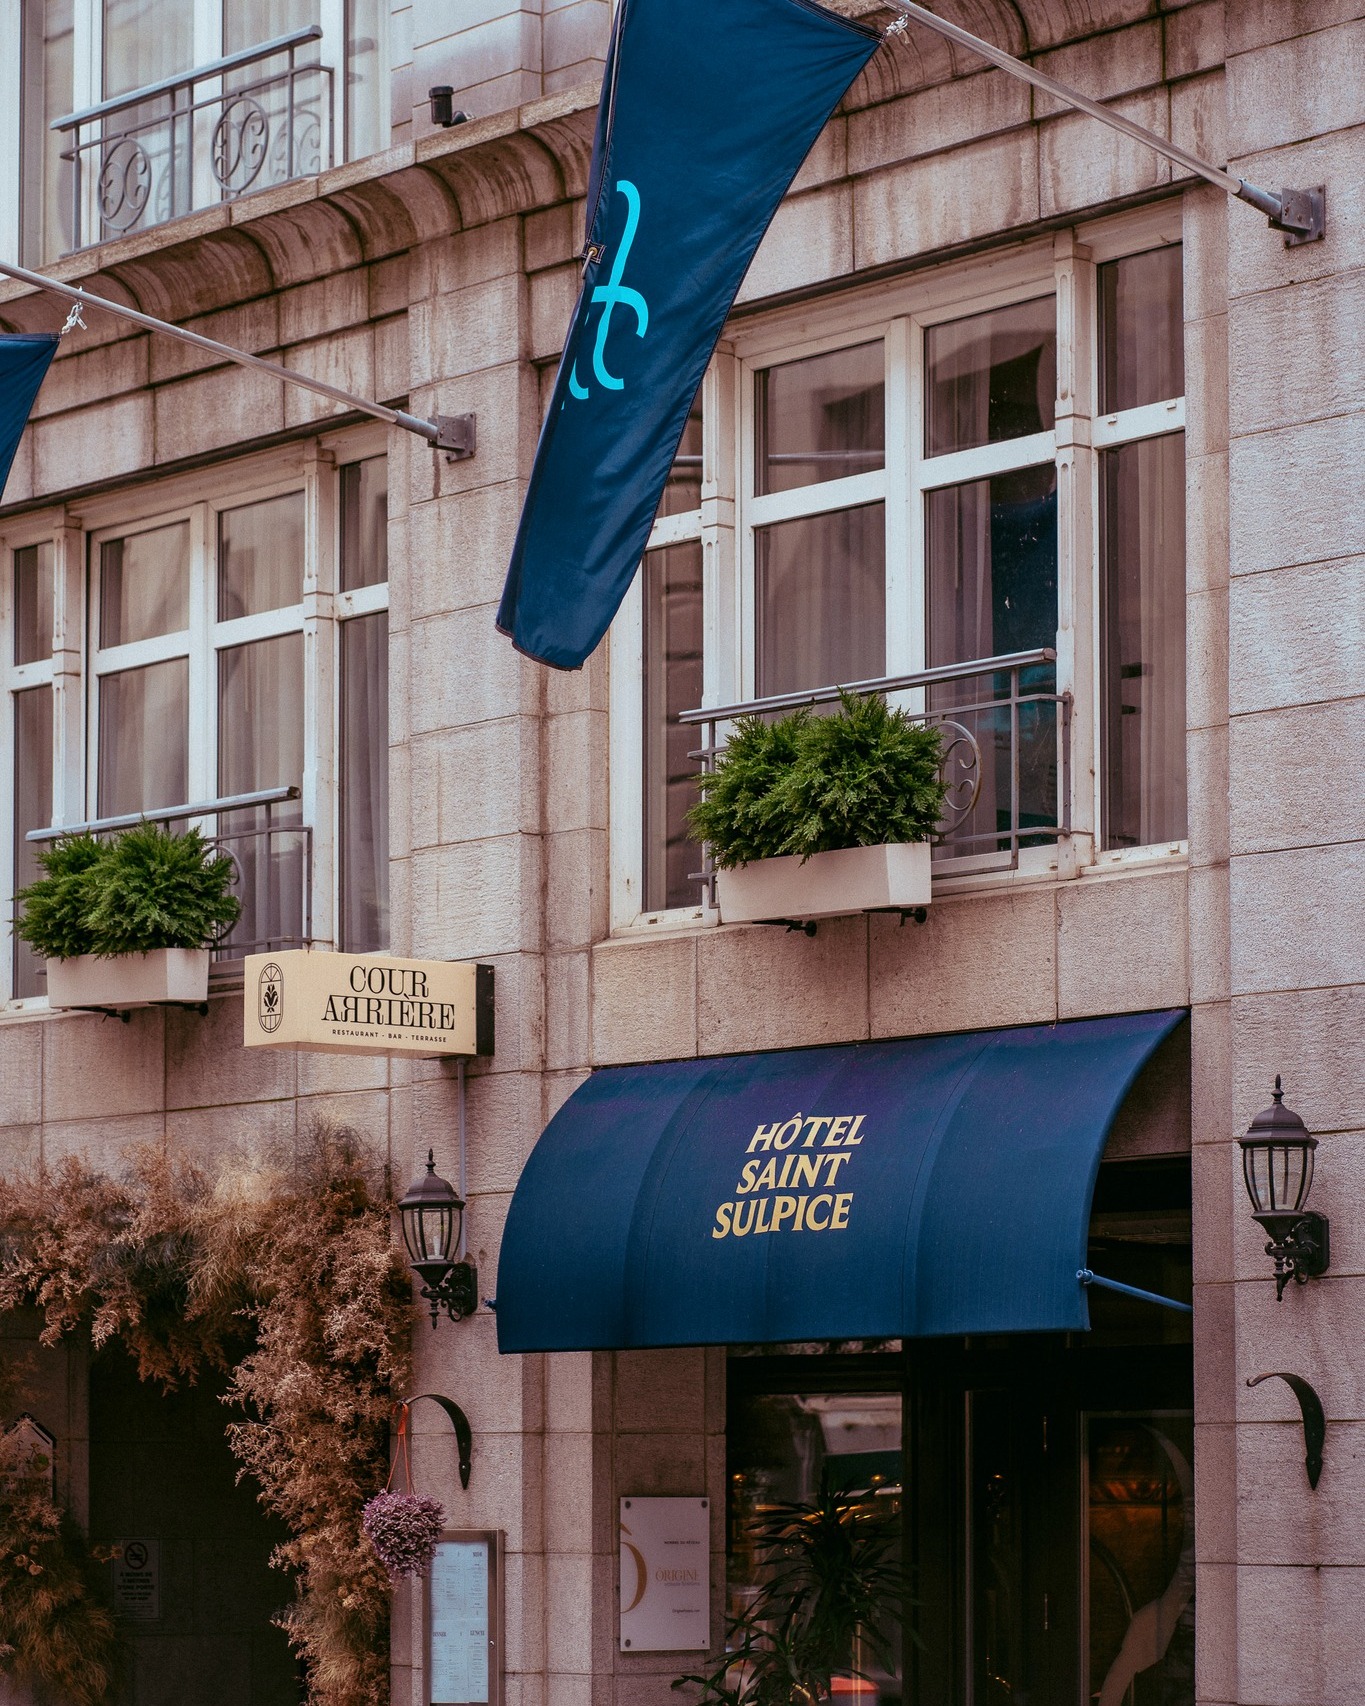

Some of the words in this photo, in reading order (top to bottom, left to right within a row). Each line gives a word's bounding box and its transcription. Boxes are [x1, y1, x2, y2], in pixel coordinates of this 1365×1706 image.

[349, 965, 429, 998] COUR
[321, 993, 455, 1030] ARRIÈRE
[332, 1029, 379, 1038] RESTAURANT
[411, 1034, 447, 1043] TERRASSE
[744, 1112, 867, 1154] HÔTEL
[735, 1152, 852, 1194] SAINT
[712, 1192, 854, 1239] SULPICE
